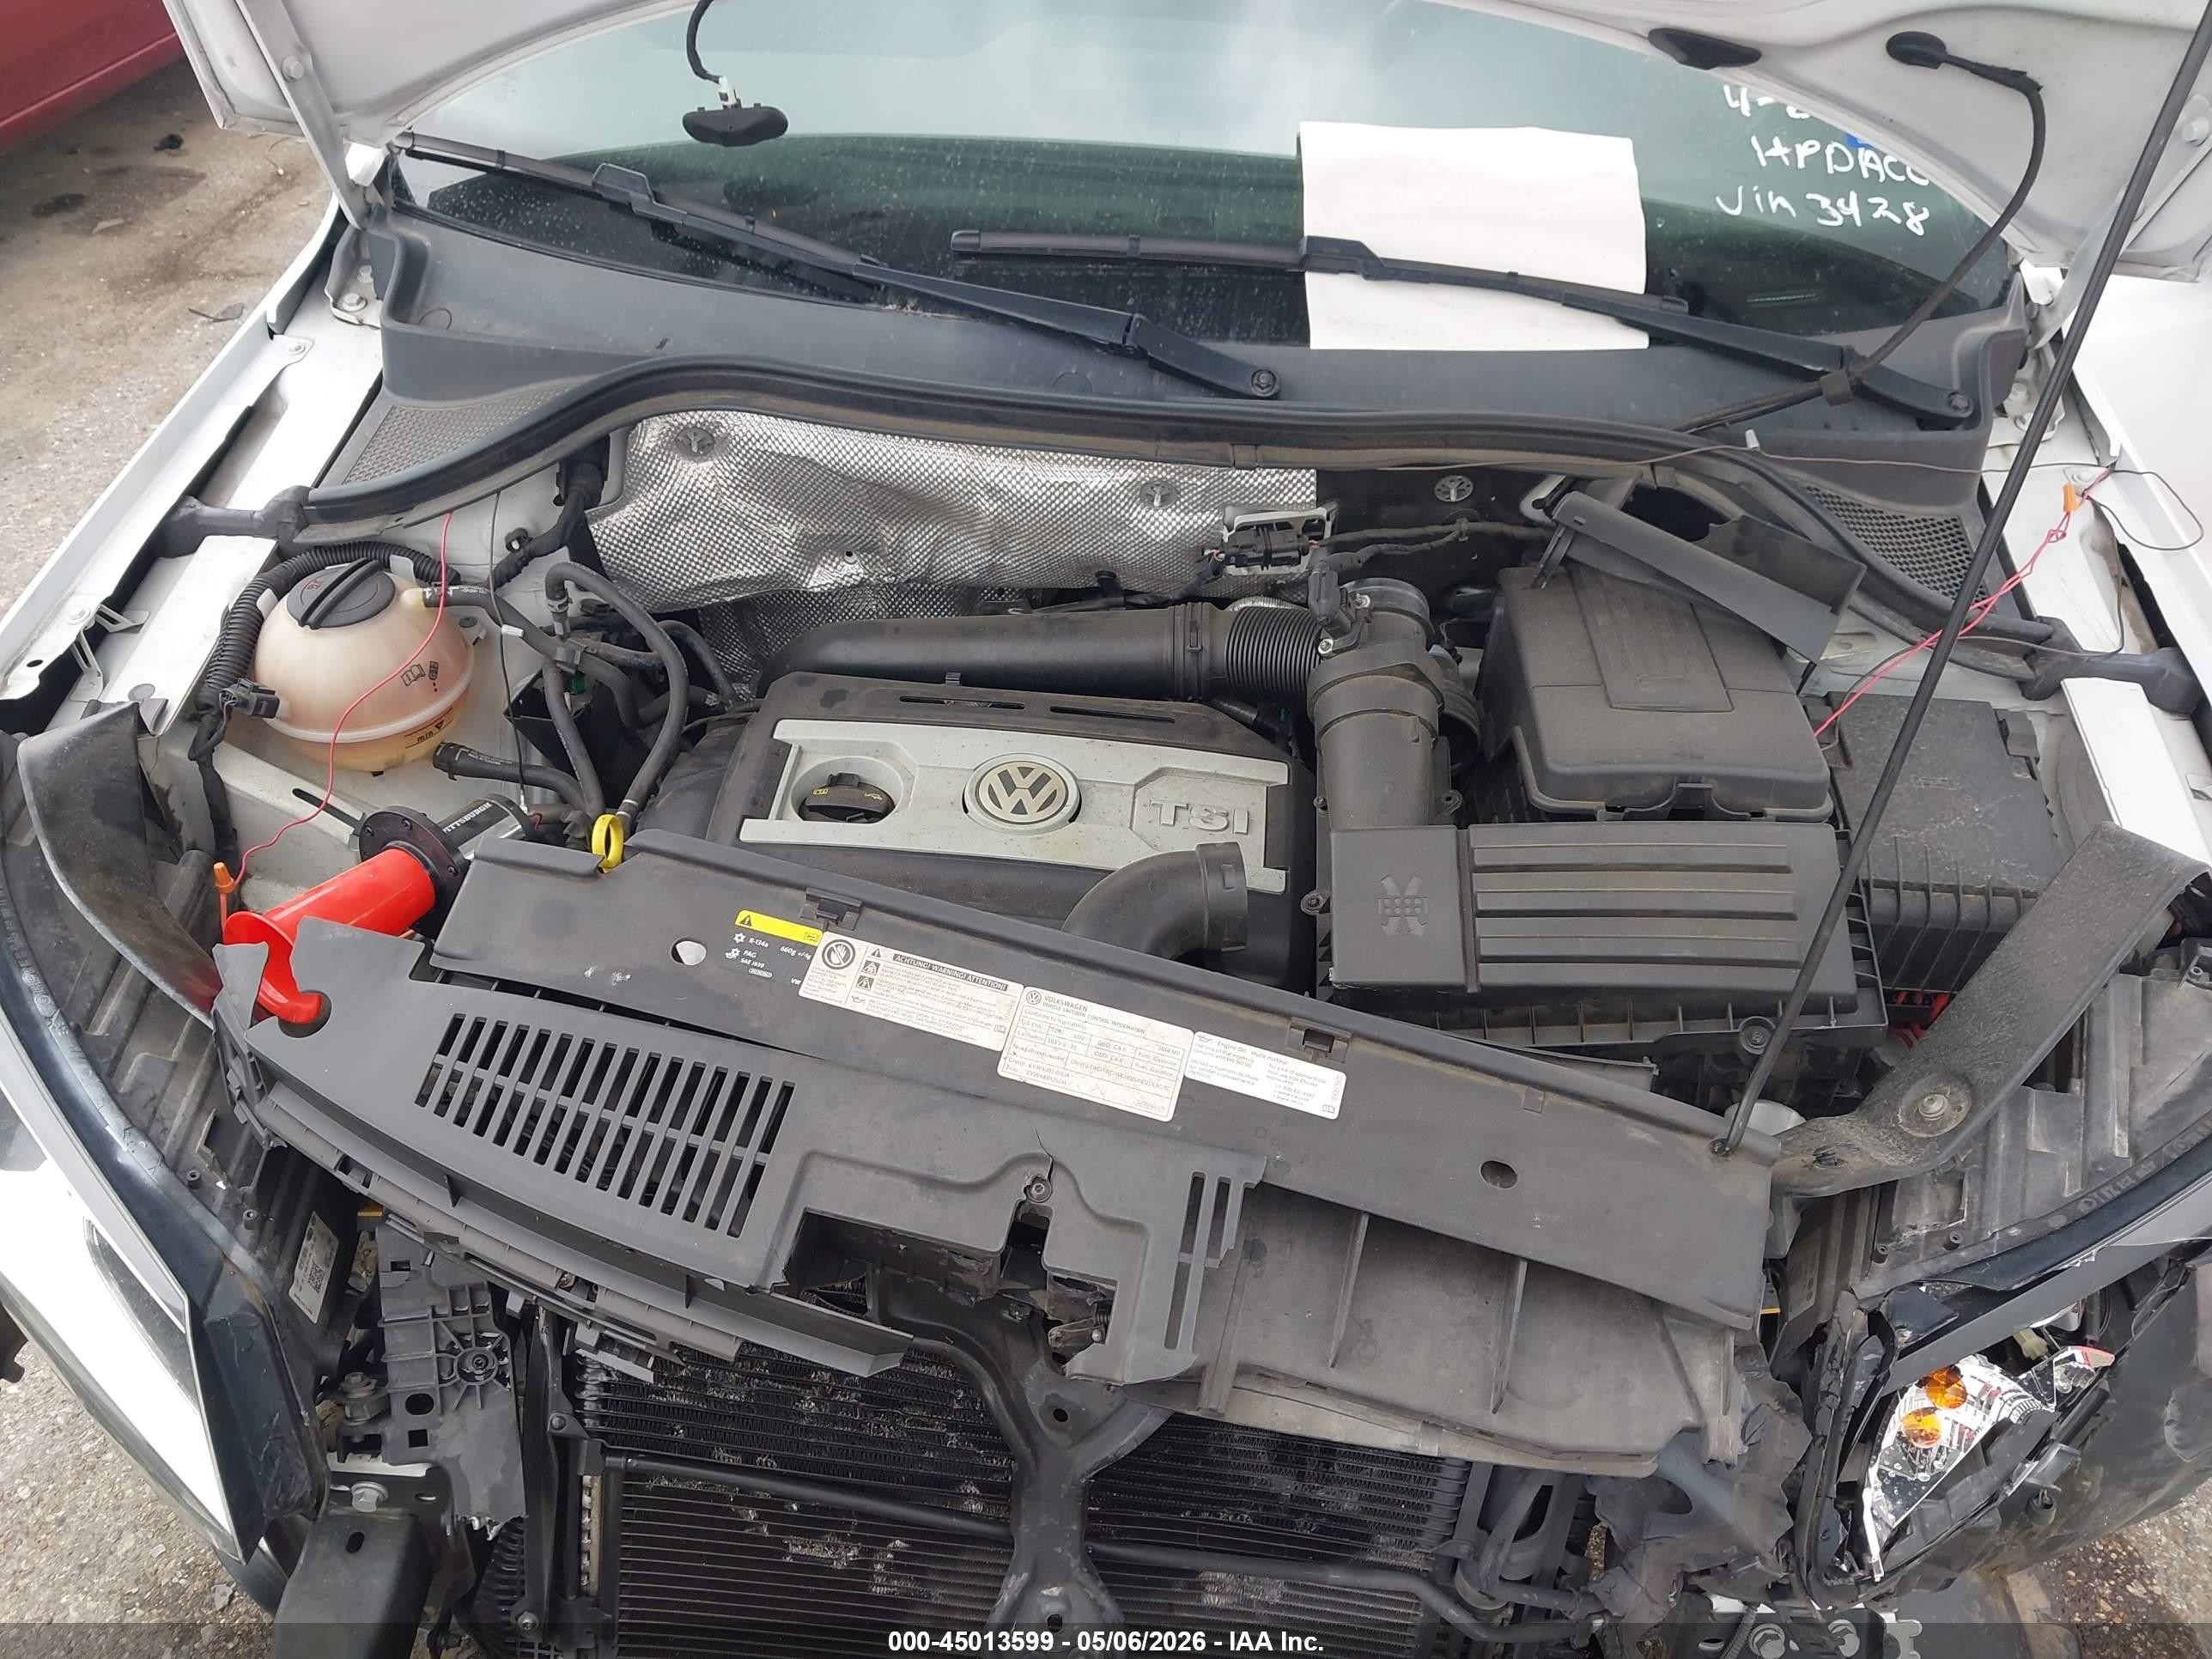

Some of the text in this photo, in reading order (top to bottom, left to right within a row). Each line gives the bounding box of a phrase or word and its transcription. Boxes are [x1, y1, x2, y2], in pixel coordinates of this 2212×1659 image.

[1806, 191, 1930, 236] 3428
[417, 731, 434, 743] min
[1150, 799, 1249, 836] TSI
[743, 949, 757, 958] PAG
[779, 945, 796, 956] 660g
[894, 955, 930, 969] ACHTUNG!
[930, 964, 966, 980] WARNING!
[966, 974, 1006, 991] ATTENTION!
[1043, 994, 1088, 1012] VOLKSWAGEN
